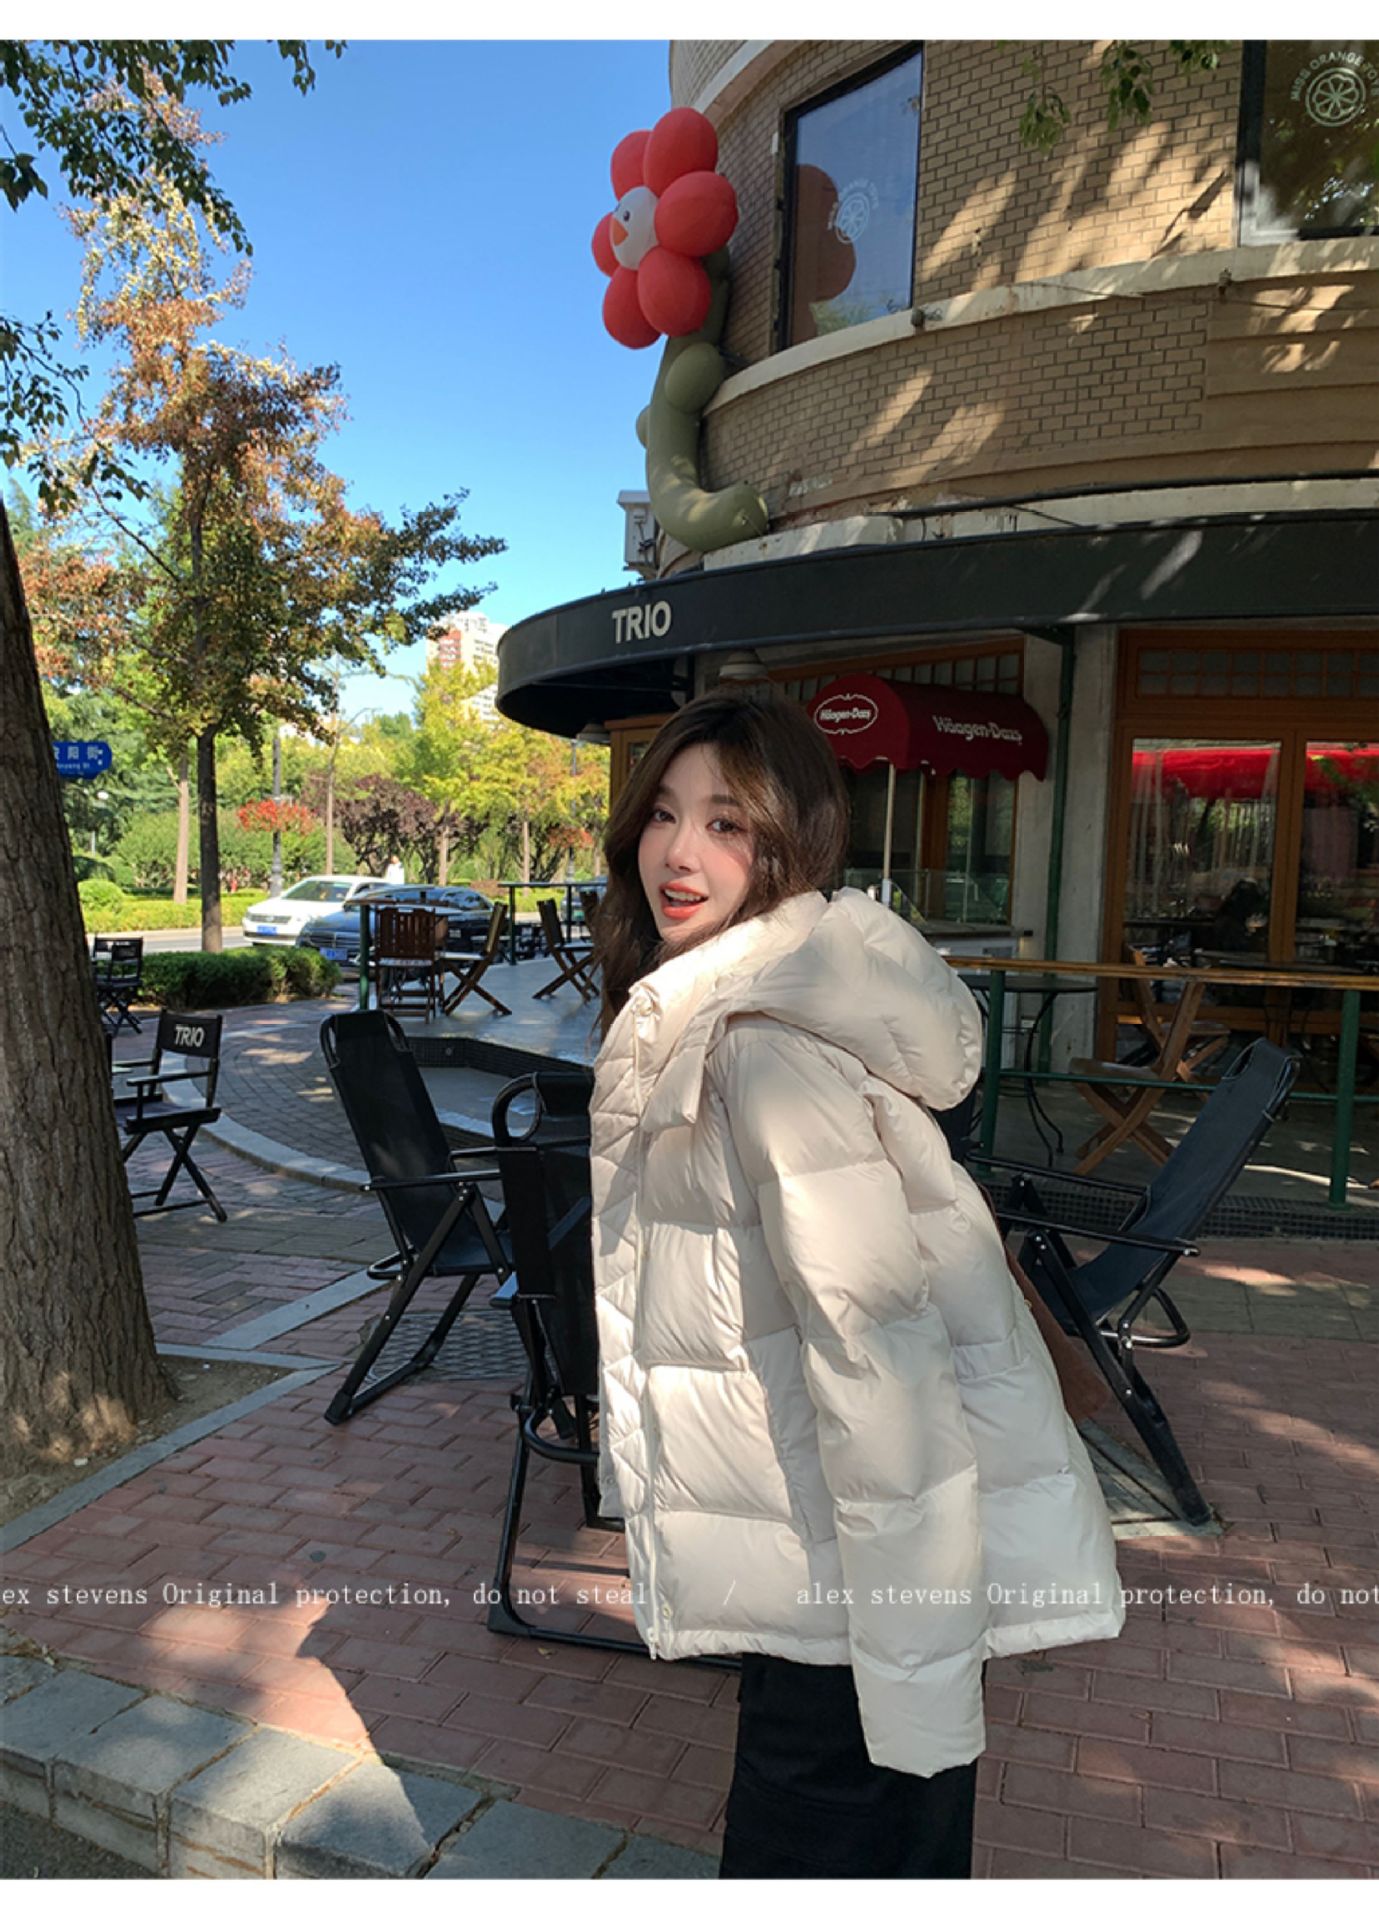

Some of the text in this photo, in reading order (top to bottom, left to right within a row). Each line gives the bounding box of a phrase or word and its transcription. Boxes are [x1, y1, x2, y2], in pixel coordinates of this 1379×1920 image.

[1309, 51, 1364, 71] ORANGE
[612, 600, 672, 644] TRIO
[820, 707, 871, 723] Häagen-Dazs
[932, 715, 1023, 743] Häagen-Dazs
[175, 1024, 205, 1048] TRIO
